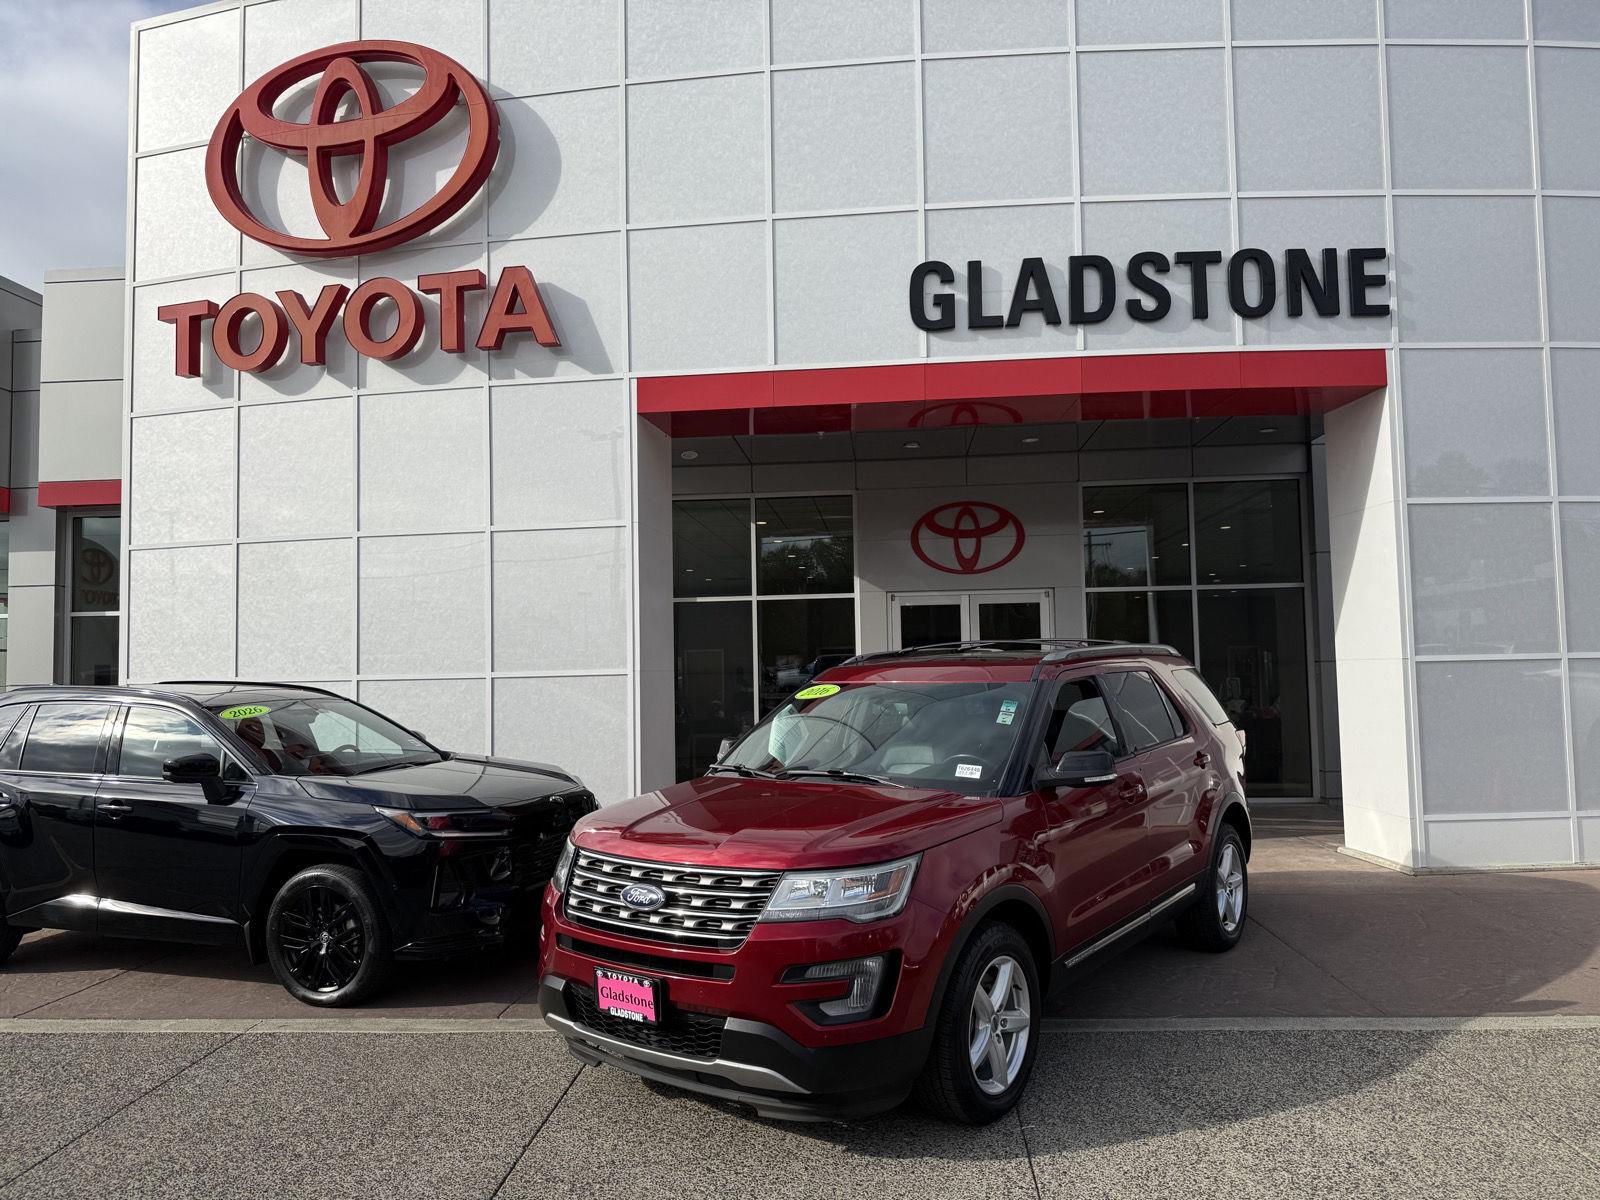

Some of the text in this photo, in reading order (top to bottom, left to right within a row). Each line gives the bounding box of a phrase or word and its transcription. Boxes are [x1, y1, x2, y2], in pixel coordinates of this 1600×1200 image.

[909, 247, 1390, 332] GLADSTONE
[157, 265, 562, 378] TOYOTA
[229, 706, 263, 718] 2026
[627, 887, 653, 904] Ford
[607, 972, 639, 984] TOYOTA
[600, 986, 654, 1010] Gladstone
[610, 1006, 644, 1022] GLADSTONE
